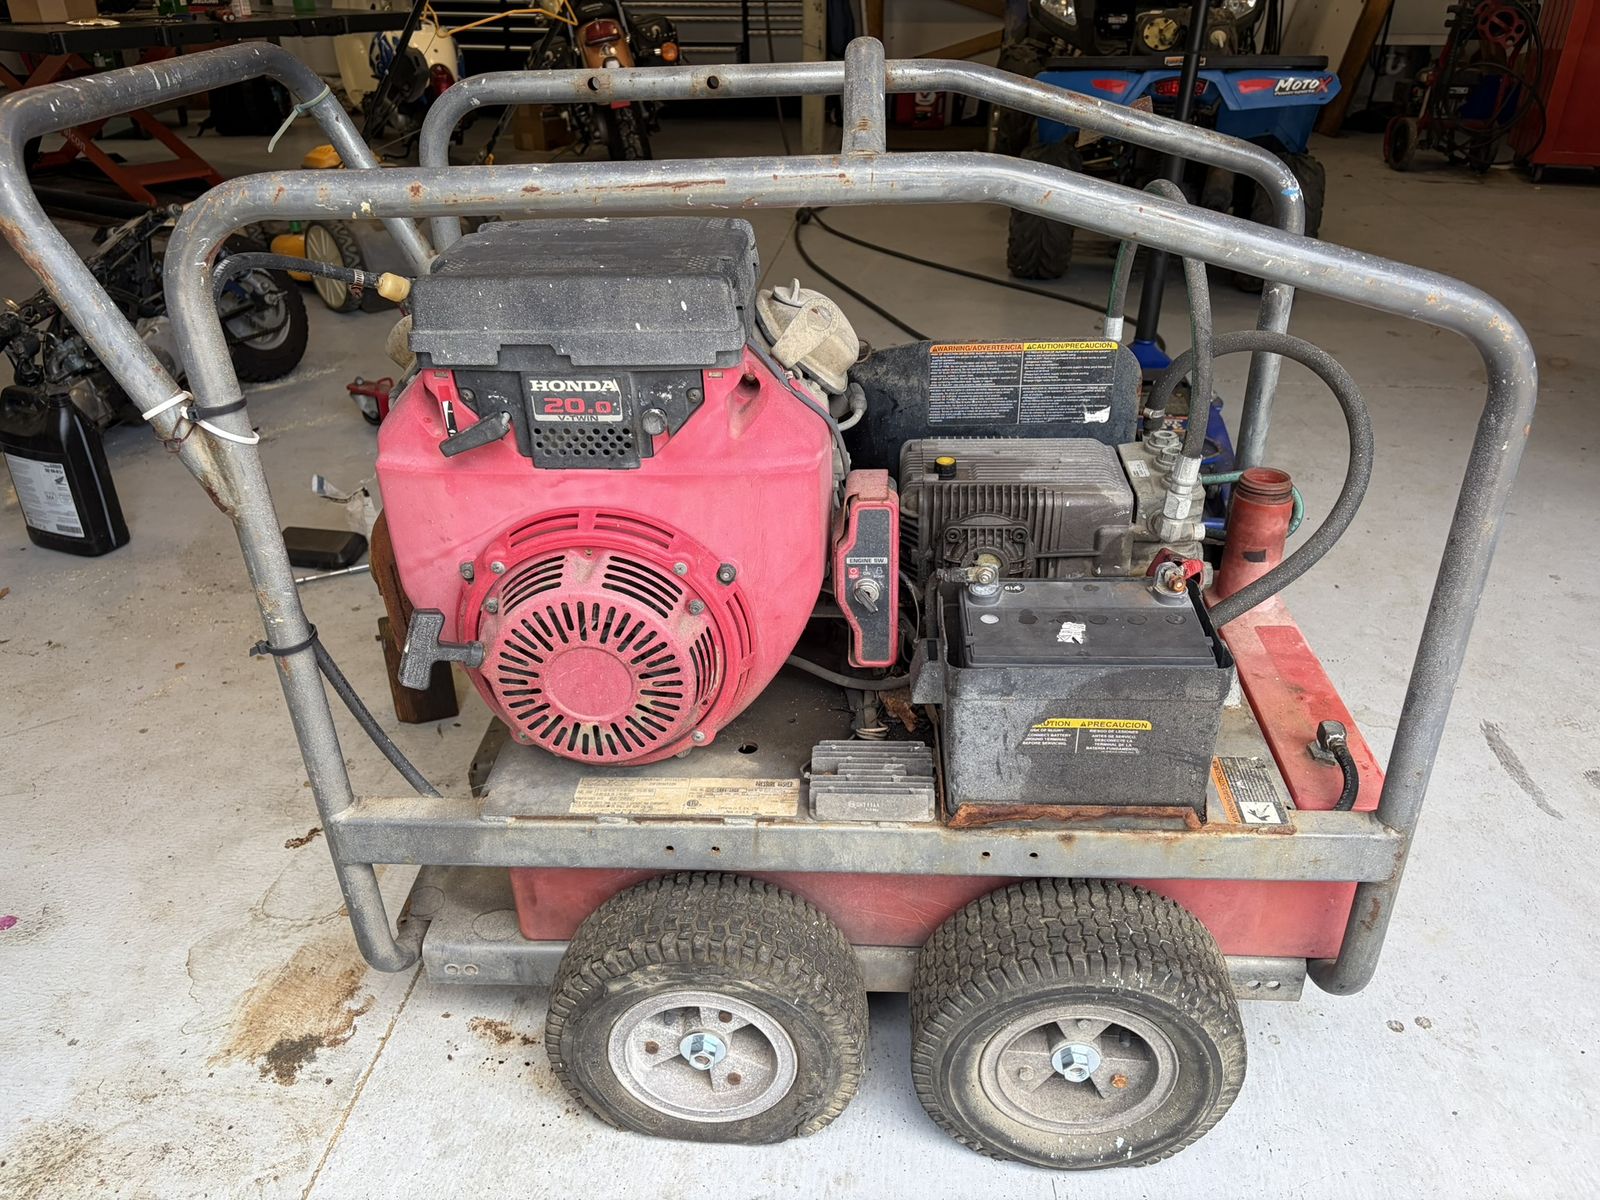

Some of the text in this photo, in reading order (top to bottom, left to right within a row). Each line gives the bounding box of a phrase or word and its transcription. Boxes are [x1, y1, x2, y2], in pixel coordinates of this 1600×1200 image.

[529, 380, 619, 392] HONDA
[543, 397, 612, 414] 20.0
[1043, 720, 1148, 729] UTION PRECAUCION
